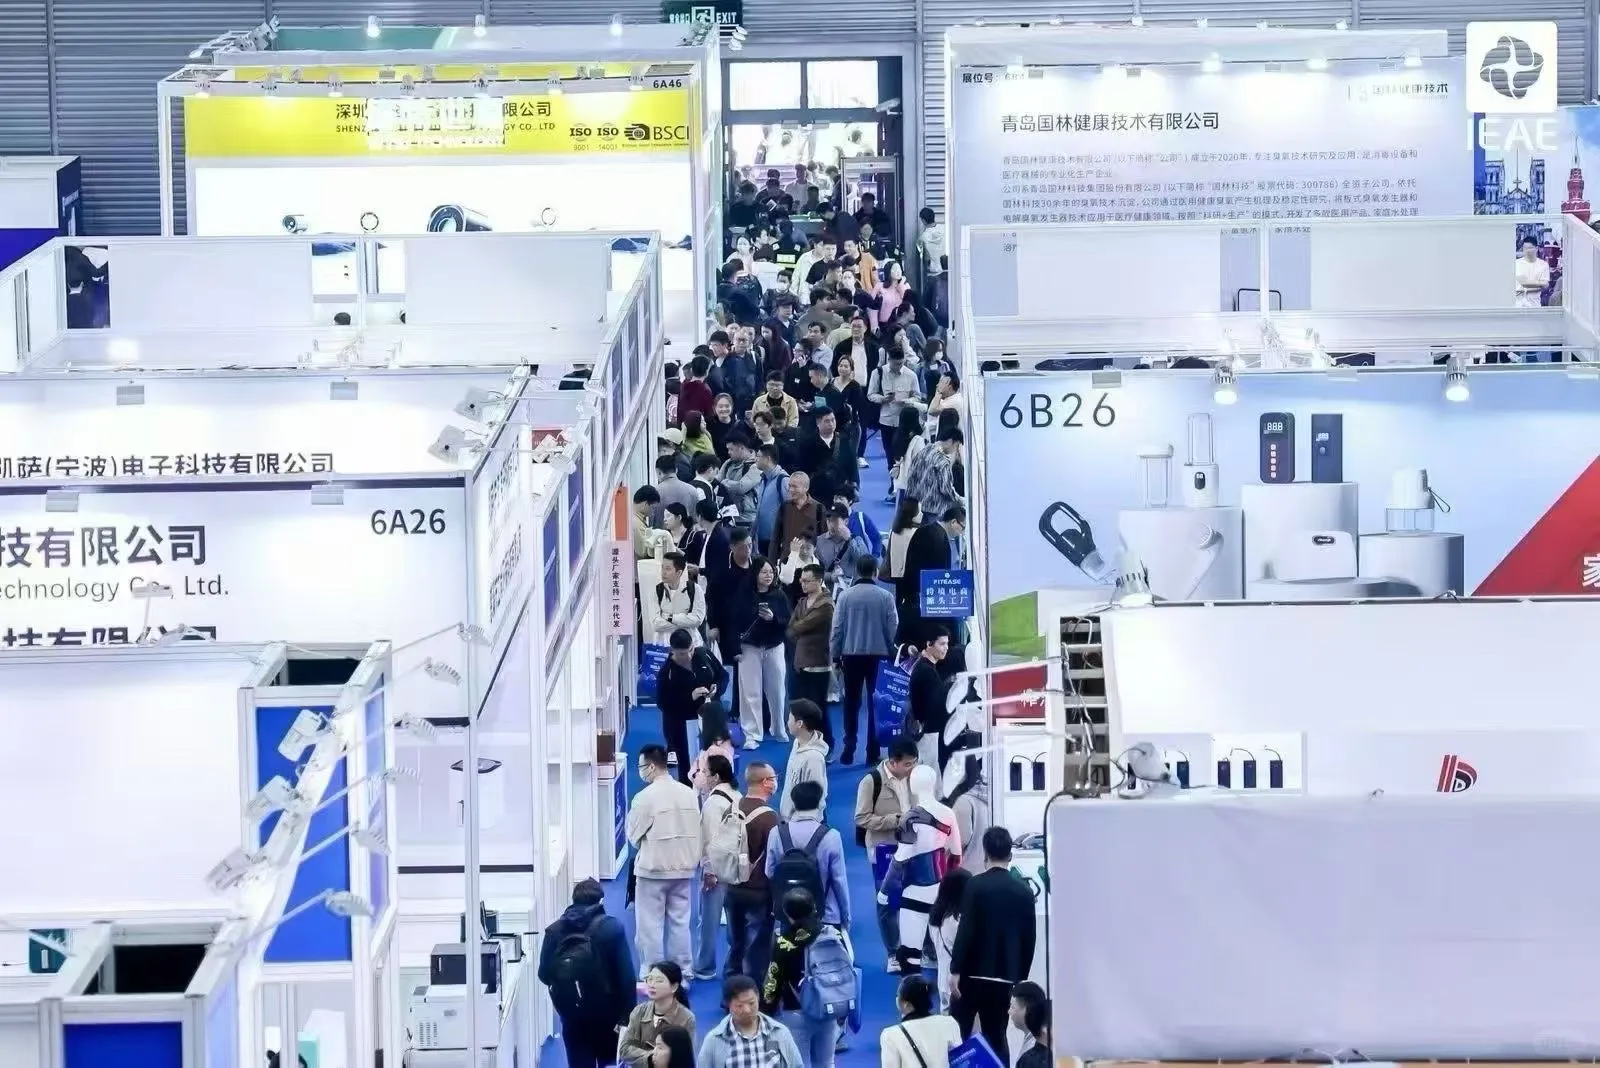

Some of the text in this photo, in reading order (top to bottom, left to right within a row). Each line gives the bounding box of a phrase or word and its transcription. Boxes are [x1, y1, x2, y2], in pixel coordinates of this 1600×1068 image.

[716, 12, 737, 23] EXIT
[653, 79, 682, 88] 6A46
[569, 127, 592, 137] ISO
[596, 126, 619, 137] ISO
[1001, 112, 1219, 132] 青岛国林健康技术有限公司
[1000, 392, 1116, 429] 6B26
[371, 508, 446, 535] 6A26
[184, 574, 229, 596] Ltd.
